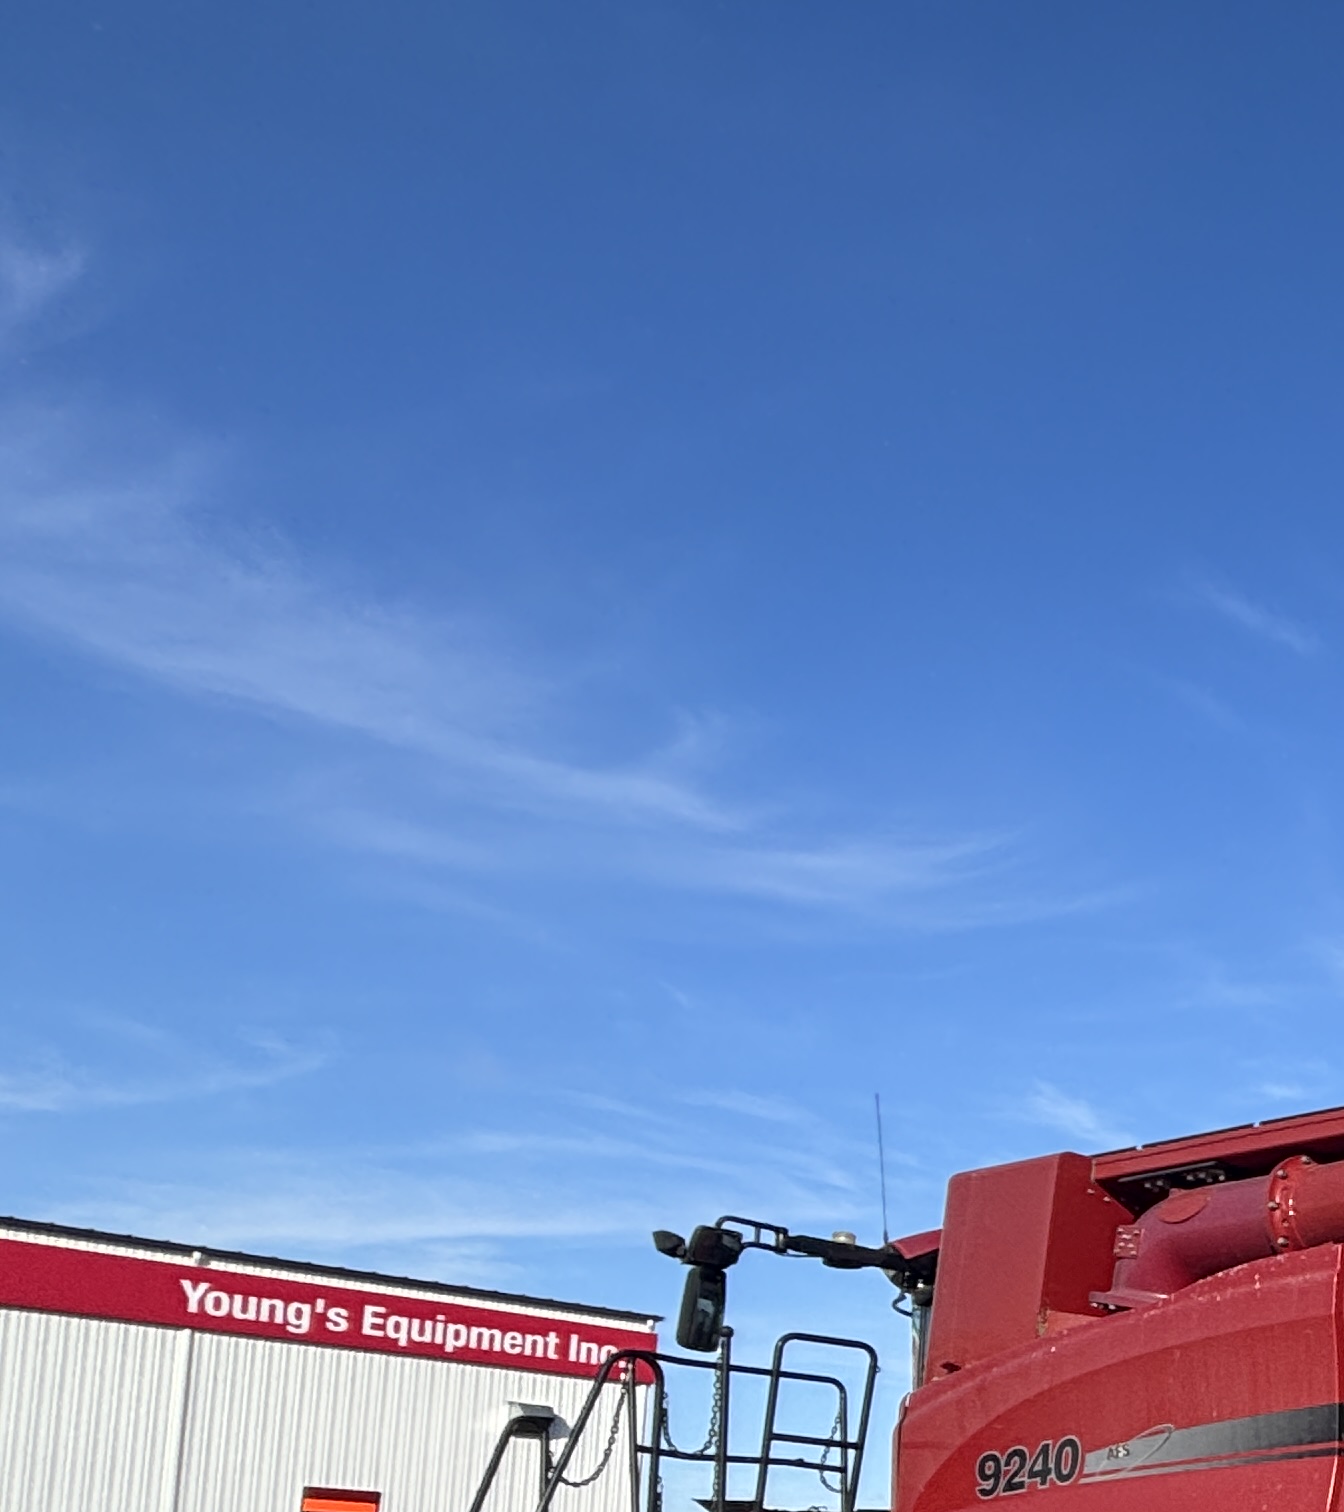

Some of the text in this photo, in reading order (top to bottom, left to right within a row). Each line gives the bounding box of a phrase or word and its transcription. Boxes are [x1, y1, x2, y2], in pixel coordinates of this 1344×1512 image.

[179, 1278, 350, 1335] Young's
[361, 1304, 560, 1361] Equipment
[976, 1435, 1131, 1500] 9240 AFS
